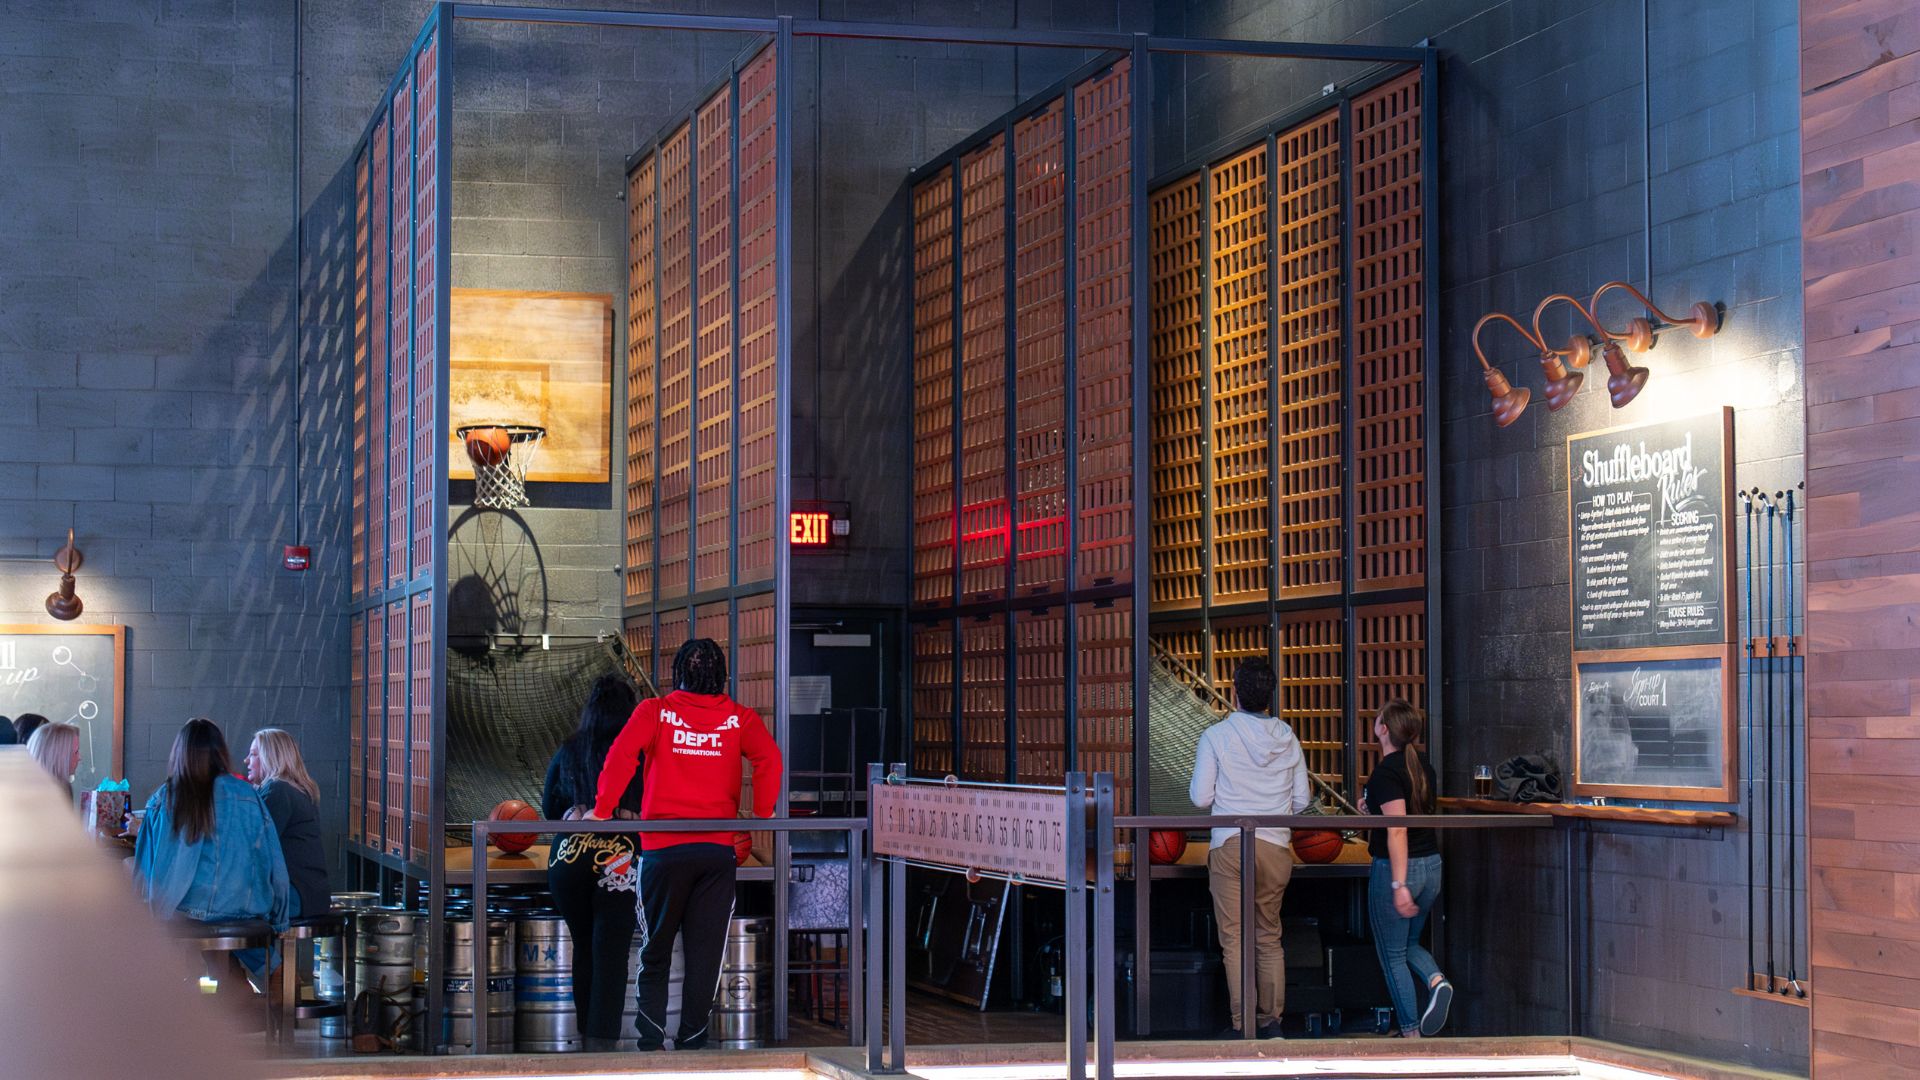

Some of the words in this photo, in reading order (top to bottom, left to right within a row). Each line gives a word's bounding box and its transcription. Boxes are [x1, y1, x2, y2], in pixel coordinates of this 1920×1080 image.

[1582, 432, 1692, 488] Shuffleboard
[1592, 494, 1605, 508] HOW
[1606, 492, 1616, 506] TO
[1616, 490, 1634, 505] PLAY
[1656, 469, 1708, 526] Rules
[790, 513, 829, 544] EXIT
[1671, 510, 1699, 526] SCORING
[1668, 607, 1687, 619] HOUSE
[1687, 605, 1705, 617] RULES
[1639, 694, 1659, 707] COURT
[1661, 678, 1668, 706] 1
[672, 747, 723, 757] INTERNATIONAL
[673, 729, 723, 748] DEPT.
[880, 805, 884, 832] 0
[888, 806, 893, 833] 5
[898, 807, 905, 833] 10
[908, 808, 915, 834] 15
[918, 809, 926, 836] 20
[928, 810, 936, 837] 25
[940, 811, 948, 838] 30
[951, 812, 959, 840] 35
[963, 813, 971, 842] 40
[975, 815, 983, 843] 45
[987, 816, 995, 845] 50
[999, 817, 1008, 846] 55
[1012, 818, 1021, 848] 60
[1025, 818, 1034, 850] 65
[1038, 820, 1048, 851] 70
[1052, 821, 1062, 852] 75
[552, 836, 578, 864] Ed
[565, 832, 627, 866] Hardy
